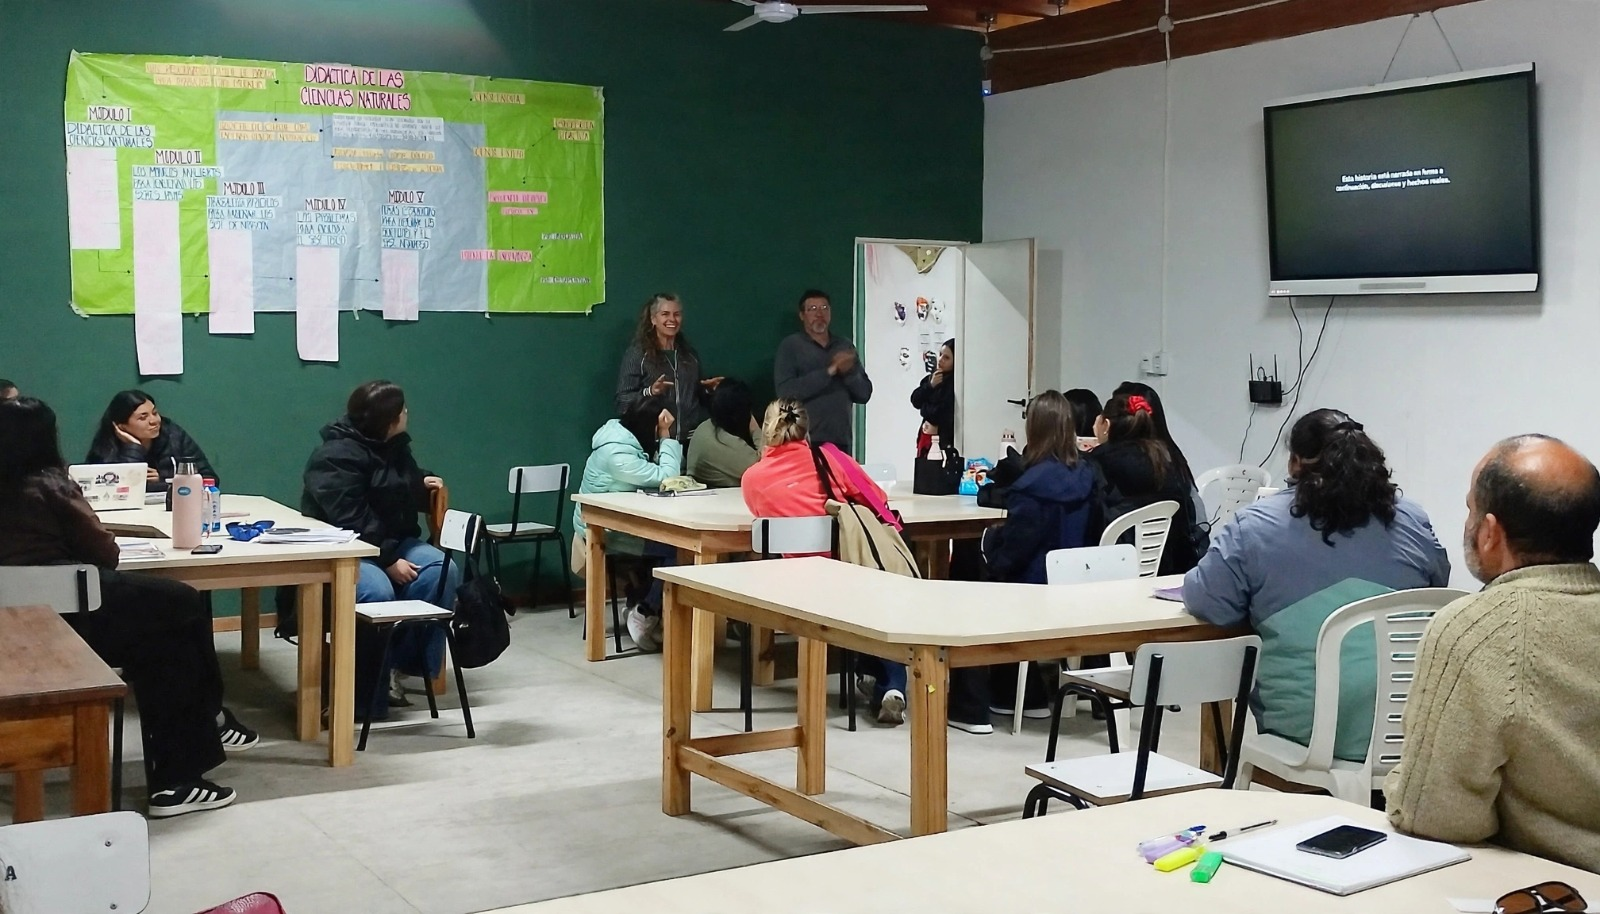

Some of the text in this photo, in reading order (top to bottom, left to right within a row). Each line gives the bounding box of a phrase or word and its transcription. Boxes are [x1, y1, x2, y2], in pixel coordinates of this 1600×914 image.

[305, 65, 404, 89] DIDACTICA DE LAS
[300, 86, 411, 111] CIENCIAS NATURALES
[127, 107, 132, 122] I
[67, 122, 151, 137] DIDACTICA DE LAS
[108, 136, 153, 148] NATURALES
[1355, 173, 1377, 181] historia
[1390, 170, 1413, 178] narrada
[1402, 180, 1407, 188] y
[1407, 178, 1429, 186] hechos
[337, 198, 347, 210] IV
[416, 191, 425, 204] V
[5, 865, 17, 881] A
